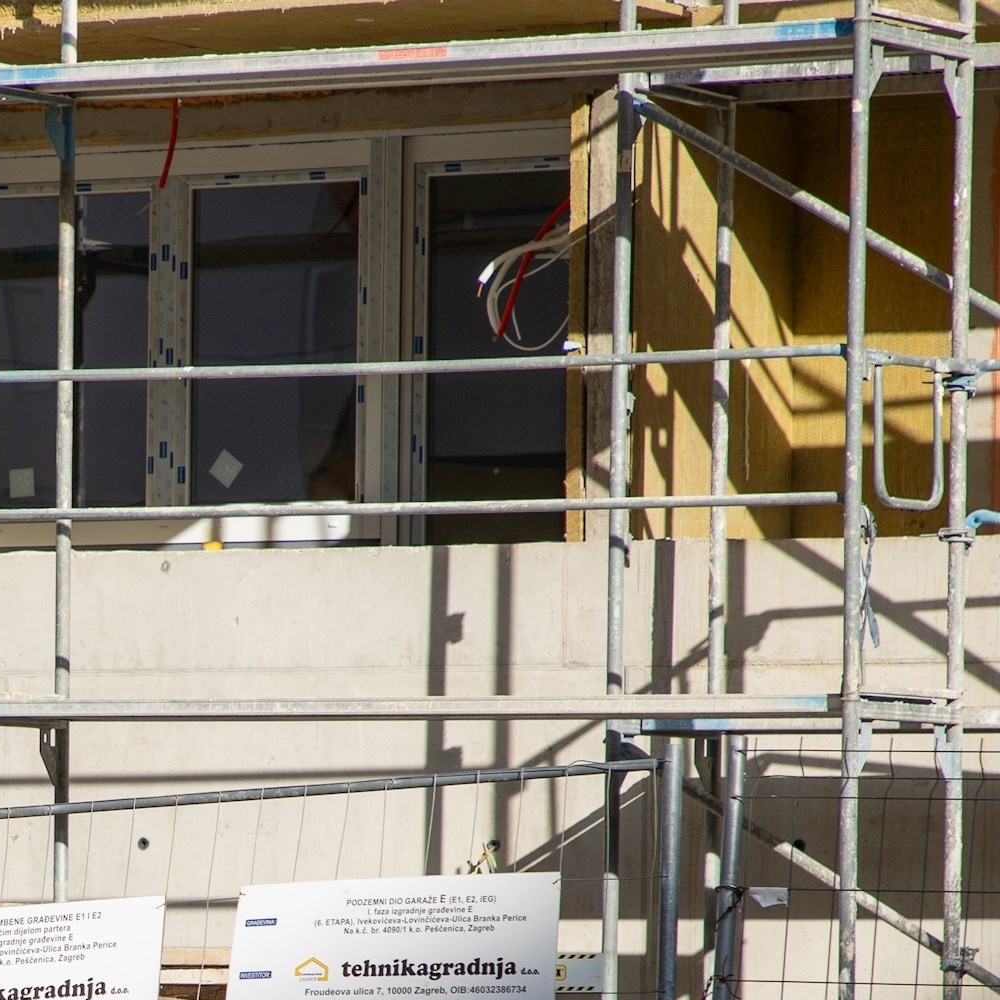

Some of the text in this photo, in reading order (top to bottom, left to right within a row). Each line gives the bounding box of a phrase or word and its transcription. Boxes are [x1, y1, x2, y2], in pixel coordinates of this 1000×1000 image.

[346, 898, 387, 906] PODZEMNI
[389, 897, 403, 905] DIO
[405, 895, 438, 905] GARAŽE
[391, 907, 426, 916] izgradnje
[426, 906, 466, 915] građevine
[27, 914, 74, 925] GRAĐEVINE
[76, 913, 85, 921] E1
[92, 911, 102, 919] E2
[14, 927, 42, 937] dijelom
[44, 925, 71, 935] partera
[64, 942, 91, 952] Branka
[93, 941, 117, 949] Perice
[341, 957, 540, 981] tehnikagradnja d.o.o.
[111, 987, 129, 995] d.o.o.
[305, 988, 351, 996] Froudeova
[353, 987, 374, 995] ulica
[387, 987, 412, 995] 10000
[414, 986, 448, 996] Zagreb,
